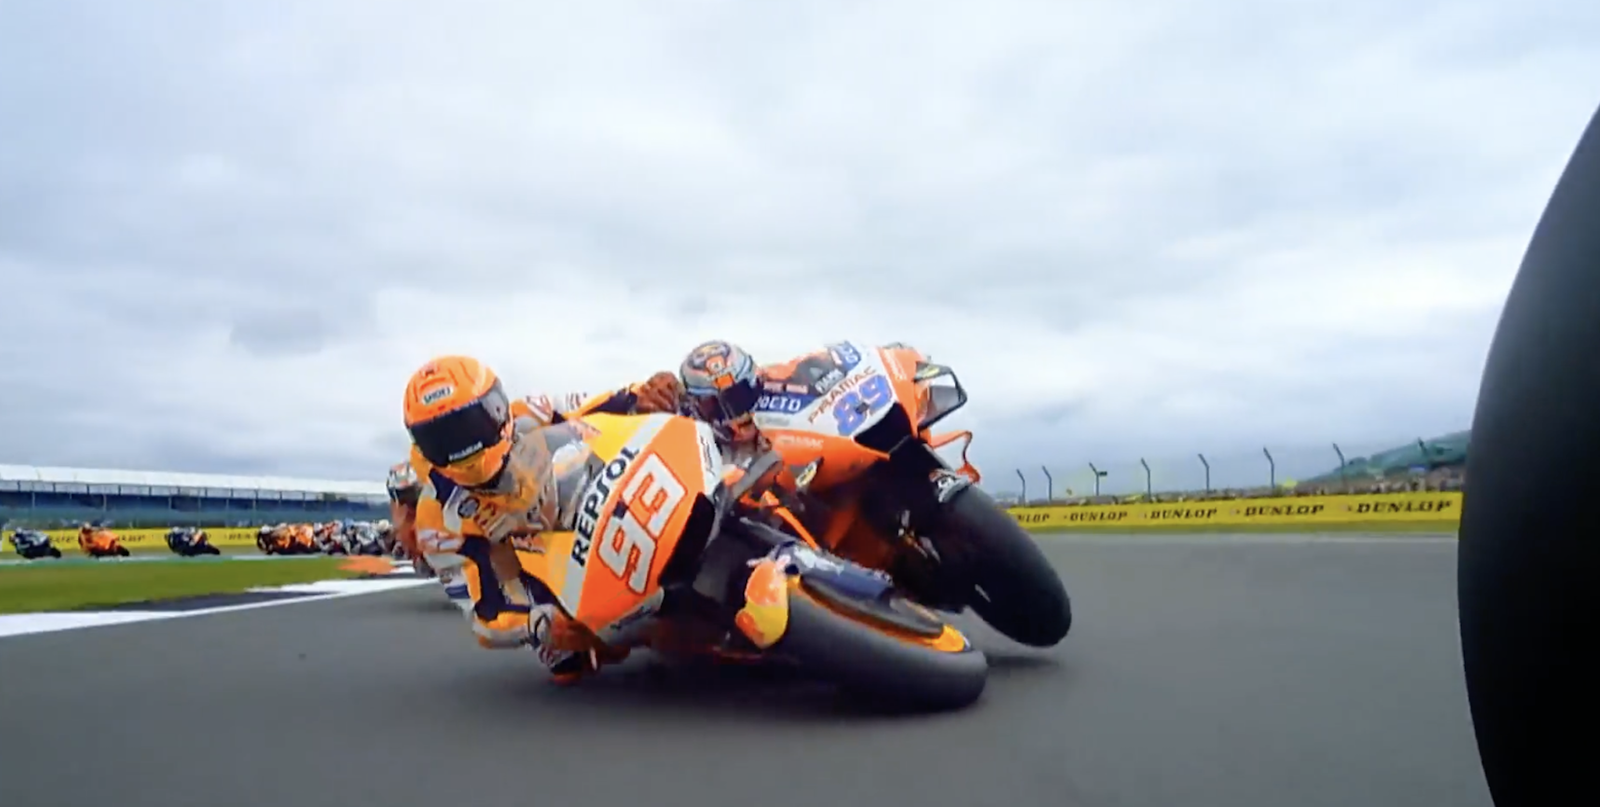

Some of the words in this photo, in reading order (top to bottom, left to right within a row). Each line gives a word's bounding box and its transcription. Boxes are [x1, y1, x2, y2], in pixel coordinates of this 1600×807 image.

[833, 374, 892, 437] 89
[571, 446, 640, 567] REPSOL
[1151, 507, 1218, 520] DUNLOP
[1244, 504, 1325, 517] DUNLOP
[1356, 500, 1452, 514] DUNLOP
[598, 450, 687, 596] 93
[1069, 511, 1128, 523] DUNLOP
